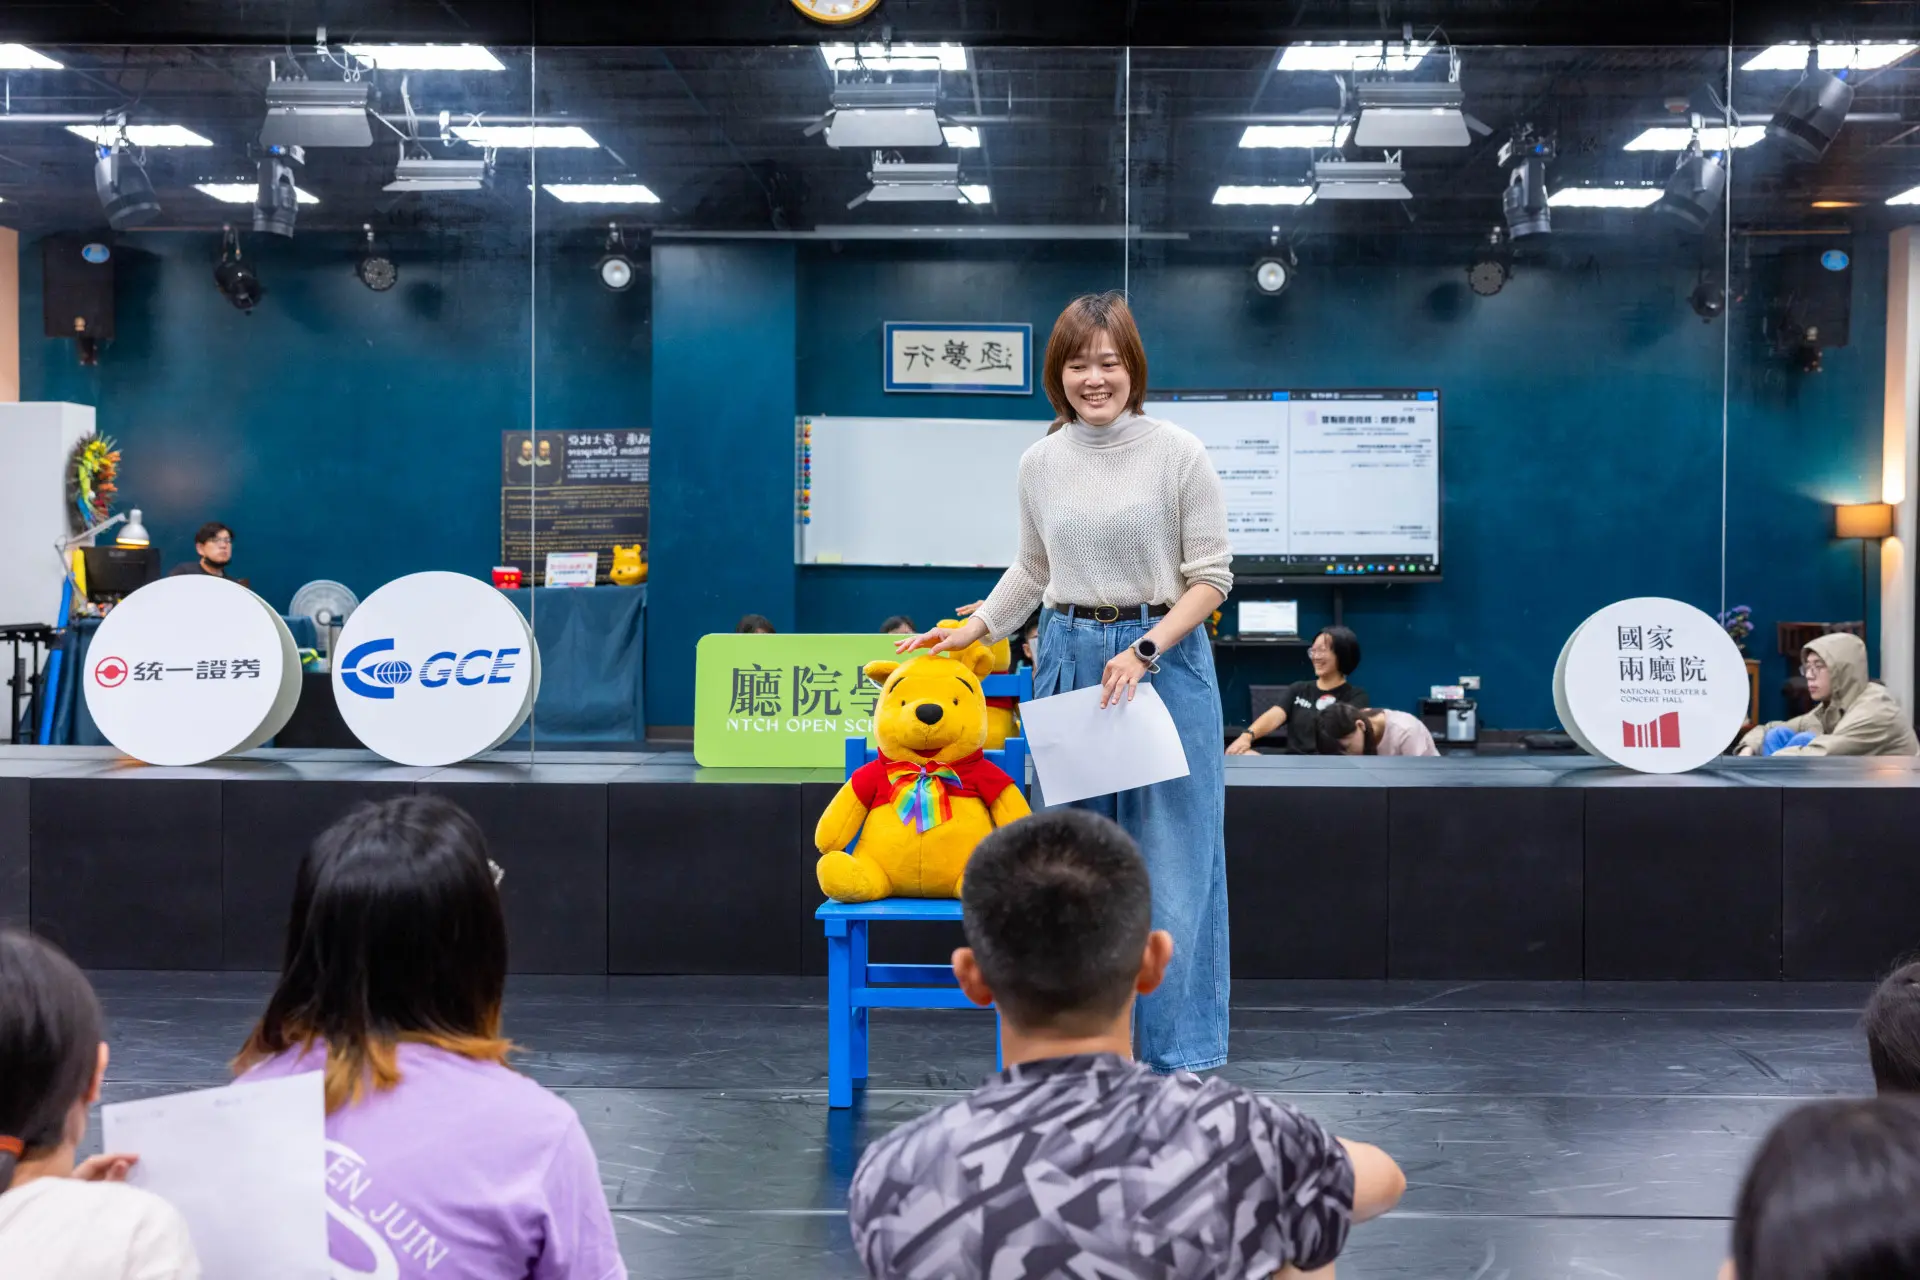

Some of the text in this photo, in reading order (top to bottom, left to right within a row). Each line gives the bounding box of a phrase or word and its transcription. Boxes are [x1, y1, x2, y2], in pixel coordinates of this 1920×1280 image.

[1617, 625, 1674, 651] 國家
[133, 659, 261, 681] 統一證券
[419, 648, 520, 688] GCE
[1618, 655, 1707, 682] 兩廳院
[727, 718, 779, 732] NTCH
[786, 718, 837, 732] OPEN
